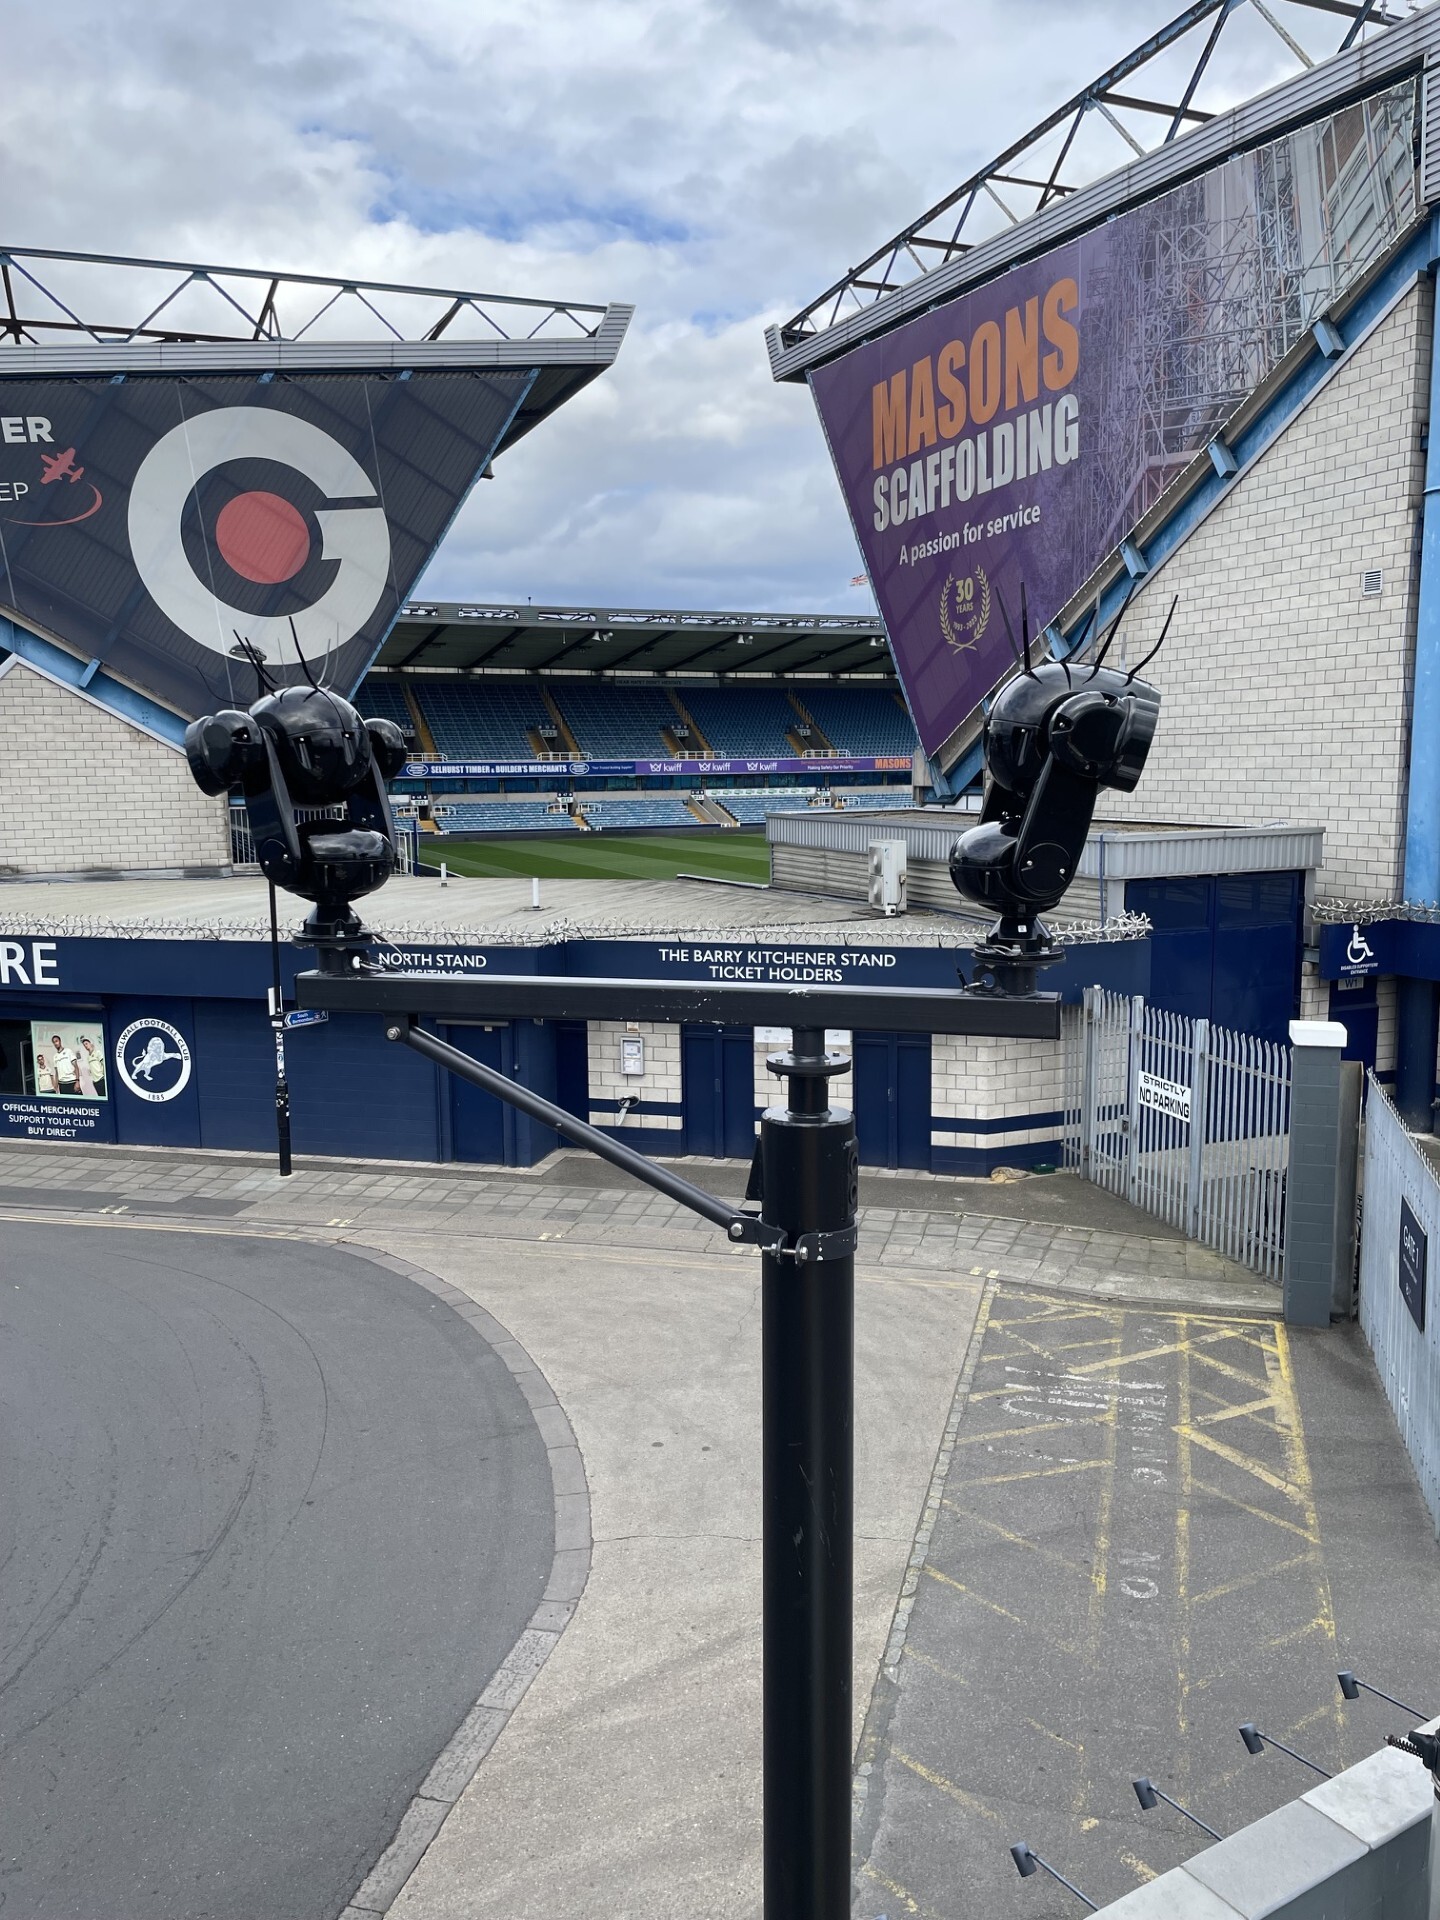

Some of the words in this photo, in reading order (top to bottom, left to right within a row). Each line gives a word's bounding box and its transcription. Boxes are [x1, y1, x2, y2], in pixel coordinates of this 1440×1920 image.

[873, 278, 1079, 470] MASONS
[873, 394, 1079, 531] SCAFFOLDING
[899, 545, 909, 565] A
[911, 532, 960, 567] passion
[963, 522, 985, 546] for
[987, 504, 1041, 538] service
[955, 577, 974, 603] 30
[955, 602, 974, 614] YEARS
[431, 765, 464, 774] SELHURST
[465, 765, 490, 774] TIMBER
[495, 765, 528, 773] BUILDER'S
[529, 764, 567, 773] MERCHANTS
[663, 763, 682, 772] kwiff
[712, 762, 731, 771] kwiff
[759, 762, 778, 771] kwiff
[874, 758, 912, 769] MASONS
[0, 941, 60, 985] RE
[378, 952, 432, 966] NORTH
[436, 953, 487, 968] STAND
[658, 949, 689, 962] THE
[693, 950, 743, 963] BARRY
[747, 951, 836, 966] KITCHENER
[841, 953, 896, 967] STAND
[709, 965, 764, 979] TICKET
[769, 967, 843, 982] HOLDERS
[118, 1023, 139, 1058] MILLWALL
[139, 1020, 178, 1038] FOOTBALL
[177, 1038, 190, 1061] CLUB
[1143, 1074, 1186, 1097] STRICTLY
[2, 1103, 39, 1113] OFFICIAL
[40, 1105, 100, 1117] MERCHANDISE
[1140, 1086, 1151, 1104] NO
[1153, 1091, 1190, 1119] PARKING
[8, 1114, 46, 1124] SUPPORT
[47, 1117, 72, 1126] YOUR
[72, 1119, 95, 1128] CLUB
[27, 1126, 45, 1135] BUY
[46, 1127, 77, 1137] DIRECT
